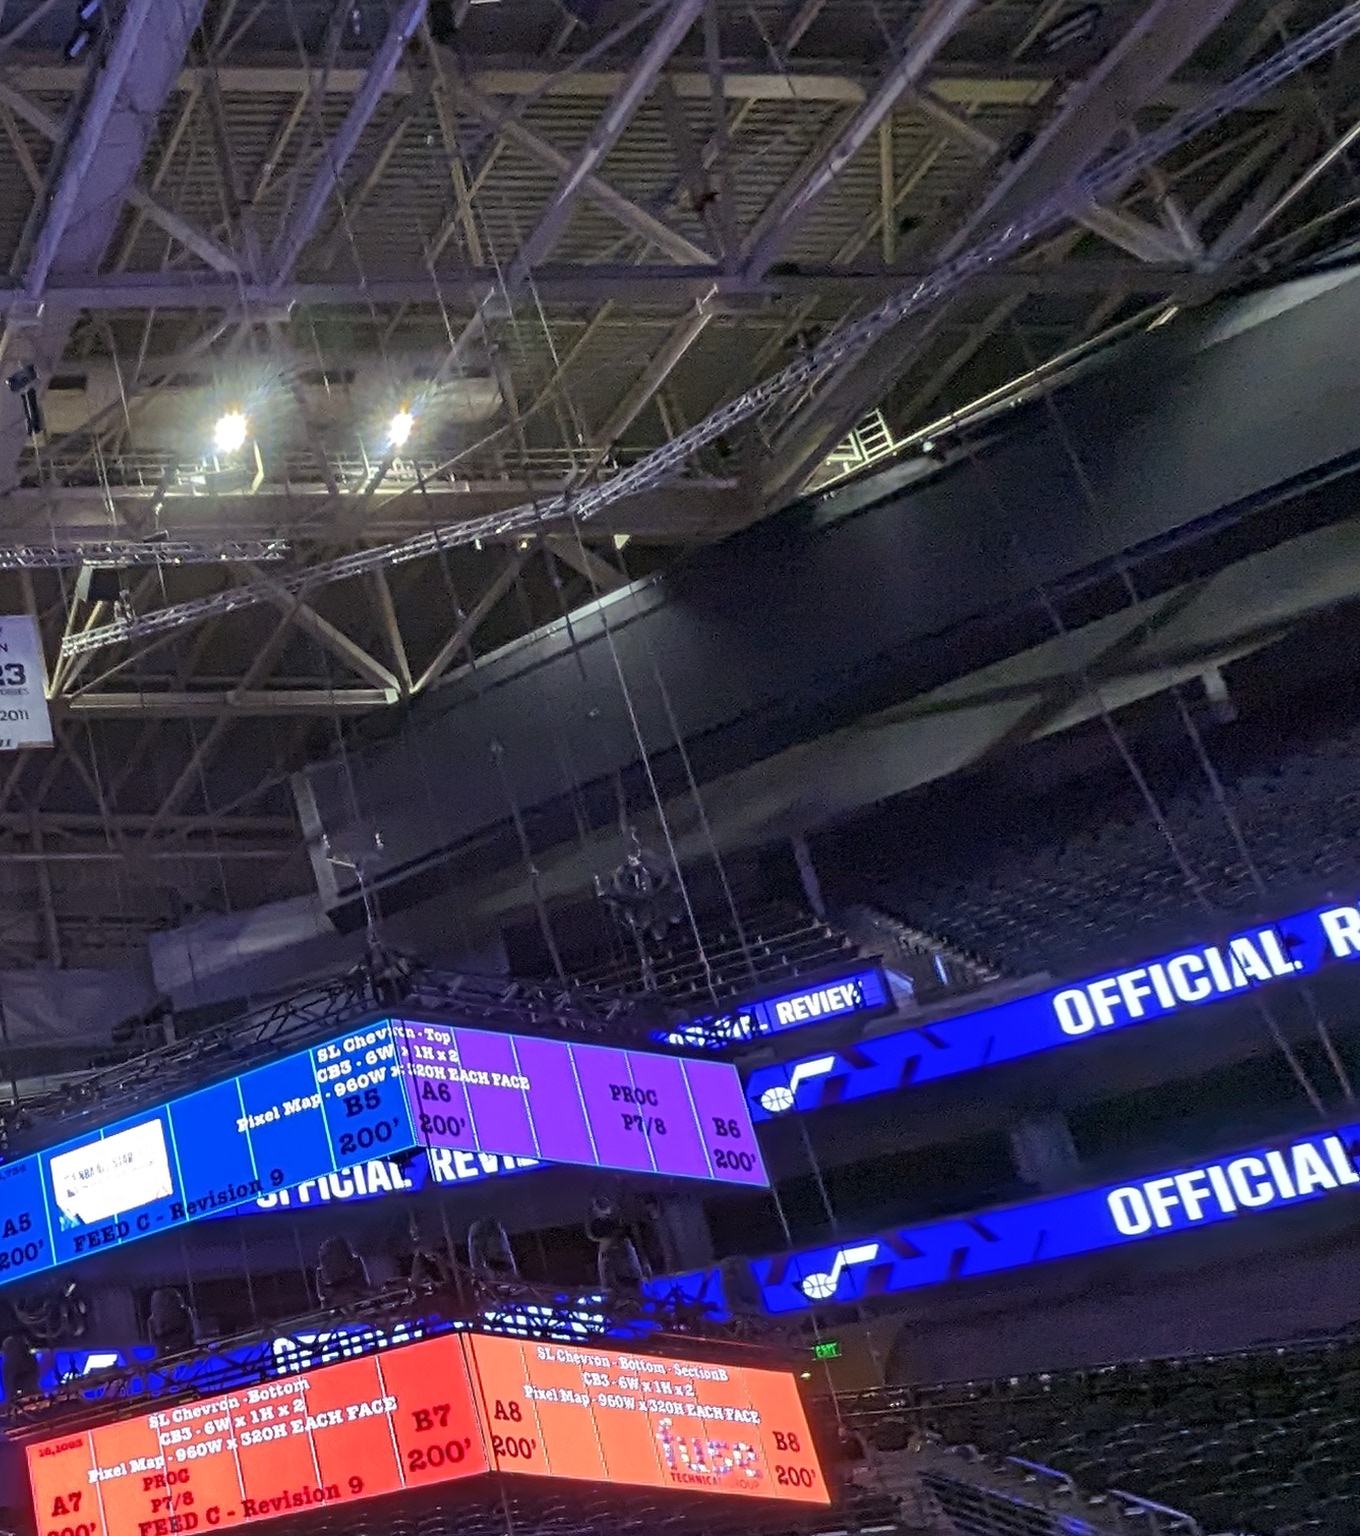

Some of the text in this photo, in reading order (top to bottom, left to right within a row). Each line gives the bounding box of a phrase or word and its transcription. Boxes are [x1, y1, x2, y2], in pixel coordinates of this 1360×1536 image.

[1051, 927, 1304, 1037] OFFICIAL
[316, 1027, 452, 1062] SL Top
[316, 1061, 353, 1084] CB3
[236, 1066, 531, 1133] Pixel Map 960W EACH FACE
[343, 1088, 382, 1118] B5
[608, 1083, 658, 1107] PROC
[338, 1117, 400, 1156] 200'
[712, 1117, 742, 1139] B6
[712, 1149, 758, 1172] 200'
[1106, 1129, 1360, 1238] OFFICIAL
[72, 1180, 263, 1253] FEED Revision
[173, 1376, 312, 1424] Chevron Bottom
[523, 1384, 558, 1403] Pixel
[412, 1404, 452, 1434] B7
[493, 1400, 522, 1423] A8
[87, 1396, 398, 1485] Pixel 960W 320H EACH FACE
[772, 1430, 801, 1453] B8
[407, 1439, 472, 1473] 200'
[142, 1467, 190, 1492] PROC
[775, 1465, 816, 1488] 200'
[51, 1491, 84, 1518] A7
[242, 1481, 342, 1520] Revision
